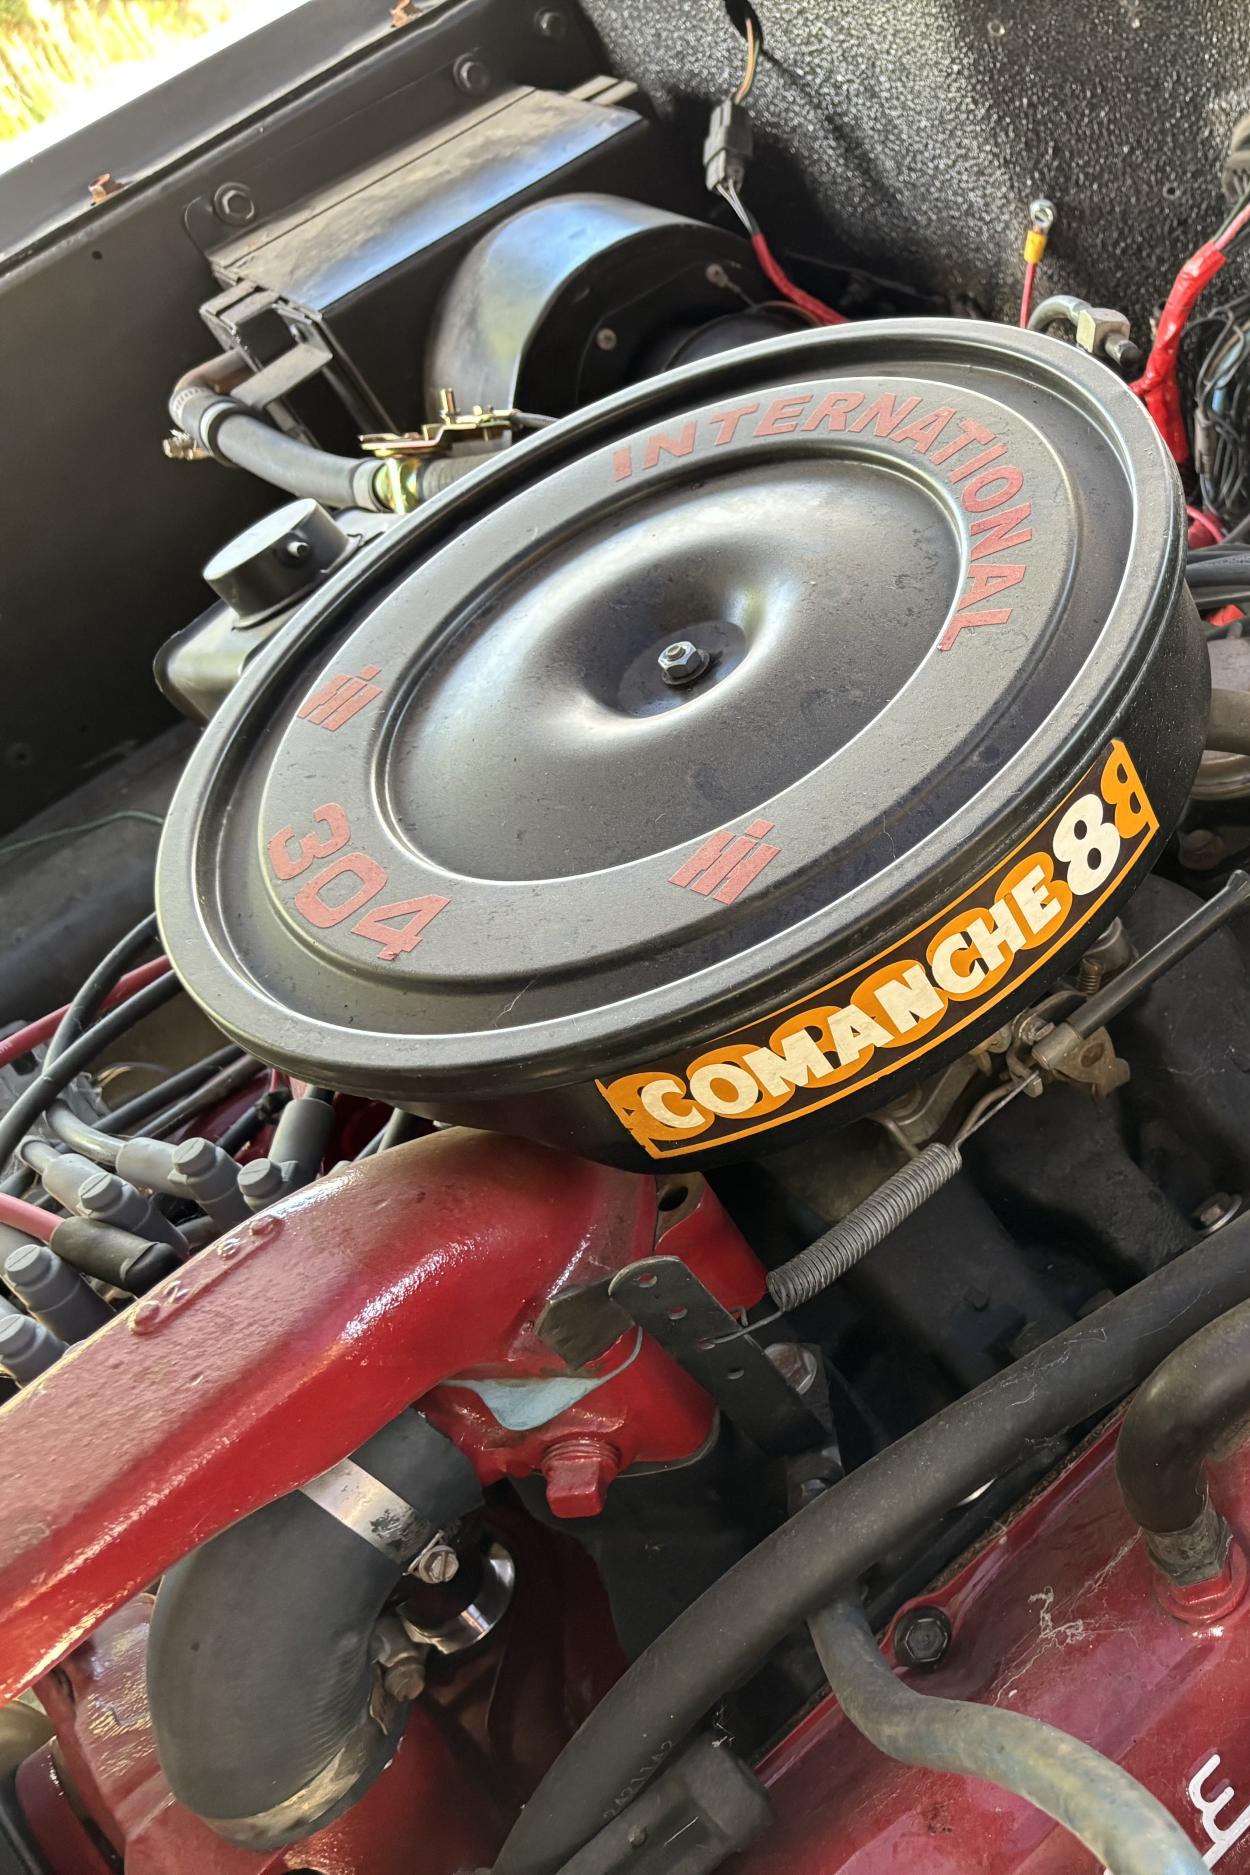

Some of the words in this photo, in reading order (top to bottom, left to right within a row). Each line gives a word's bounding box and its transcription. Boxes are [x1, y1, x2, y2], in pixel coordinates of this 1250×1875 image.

[612, 391, 1033, 652] INTERNATIONAL
[267, 802, 452, 962] 304
[640, 863, 1062, 1130] COMANCHE
